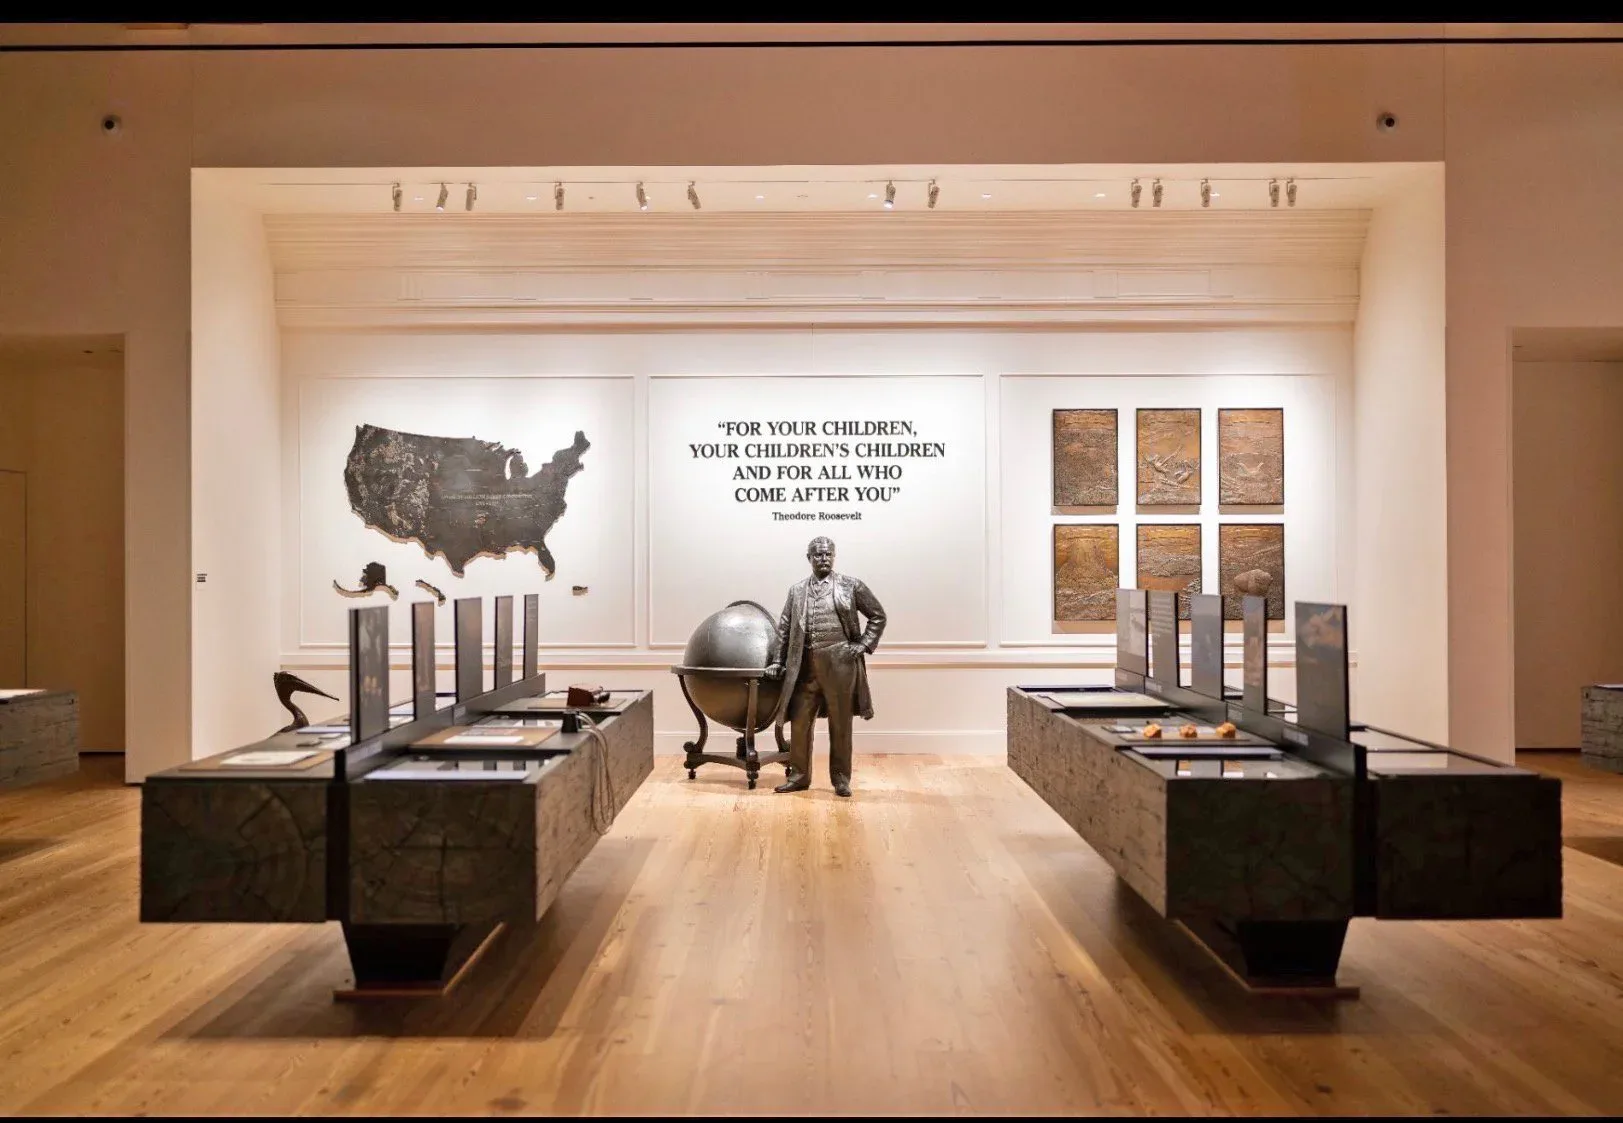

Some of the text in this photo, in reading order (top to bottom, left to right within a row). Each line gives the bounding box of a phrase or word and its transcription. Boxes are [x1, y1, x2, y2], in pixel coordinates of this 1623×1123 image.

[767, 421, 817, 436] YOUR
[822, 421, 917, 438] CHILDREN,
[689, 443, 740, 458] YOUR
[855, 443, 945, 458] CHILDREN
[733, 465, 903, 480] AND FOR ALL WHO
[734, 487, 787, 502] COME
[791, 487, 849, 502] AFTER
[772, 511, 862, 521] Theodore Roosevelt
